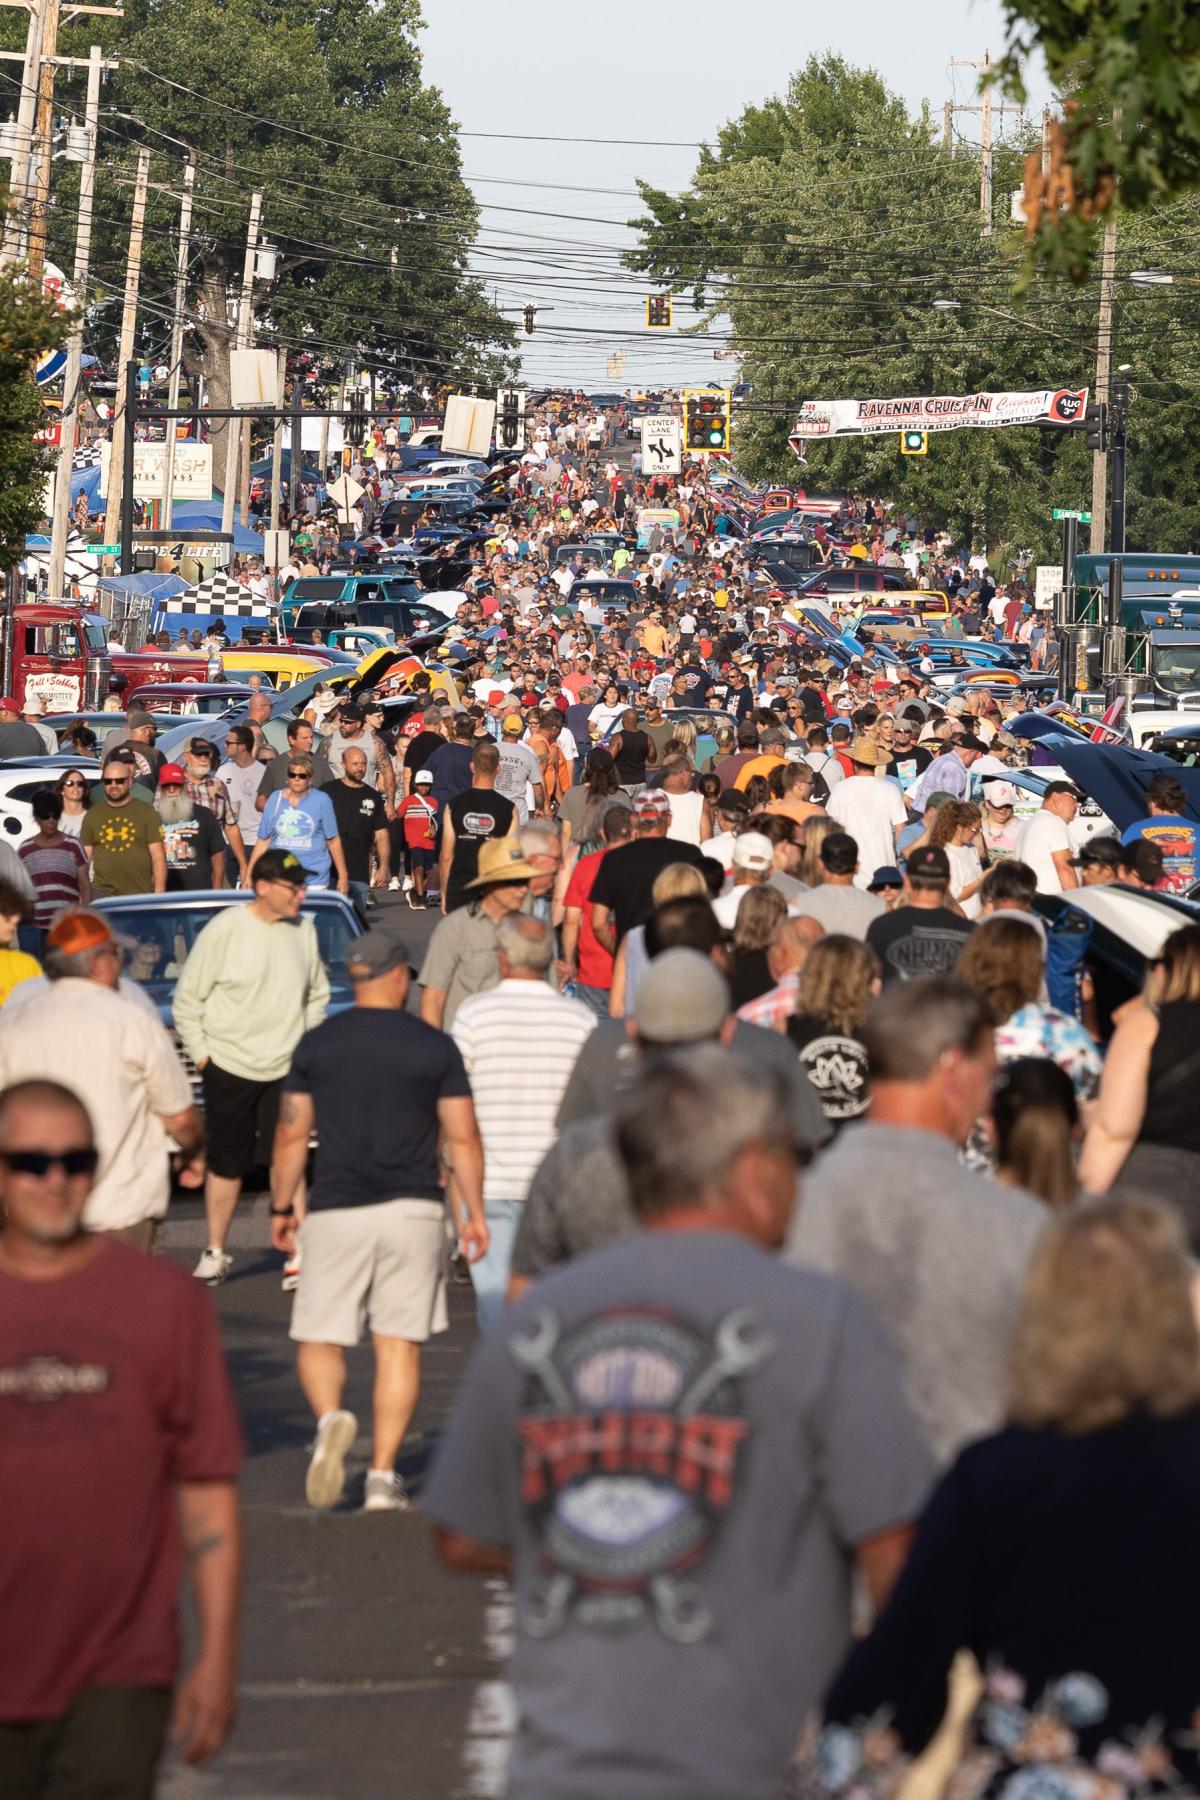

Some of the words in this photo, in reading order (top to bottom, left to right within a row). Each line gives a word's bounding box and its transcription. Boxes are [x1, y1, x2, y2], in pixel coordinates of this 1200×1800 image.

[858, 401, 921, 417] RAVENNA
[925, 395, 990, 414] CRUISE-IN
[1060, 398, 1082, 408] AUG
[89, 546, 107, 554] GROVE
[169, 543, 184, 561] 4
[186, 546, 222, 558] LIFE
